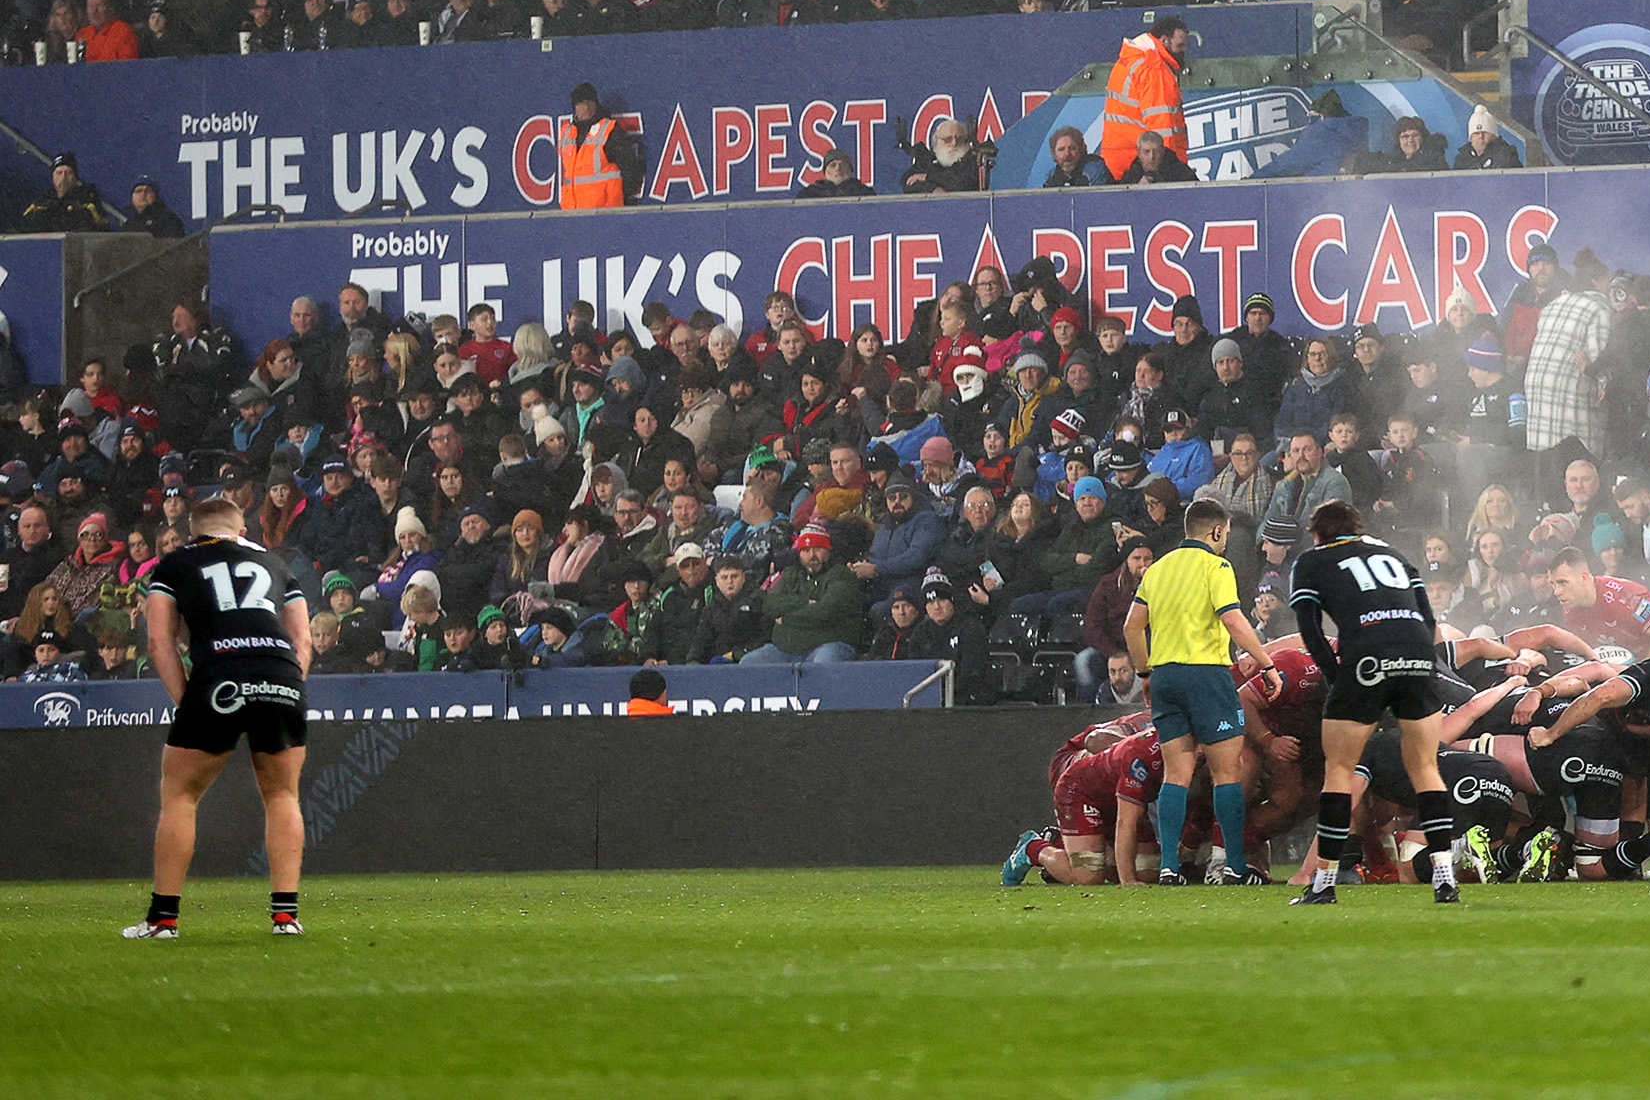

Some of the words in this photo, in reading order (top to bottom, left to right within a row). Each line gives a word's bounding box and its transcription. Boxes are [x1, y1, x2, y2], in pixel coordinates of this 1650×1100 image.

[1589, 64, 1635, 79] THE
[181, 110, 258, 136] Probably
[1187, 97, 1290, 148] THE
[1596, 122, 1630, 133] WALES
[178, 136, 308, 220] THE
[332, 125, 489, 213] UK'S
[351, 229, 449, 261] Probably
[349, 261, 508, 320] THE
[1290, 203, 1560, 331] CARS
[201, 561, 277, 615] 12
[1337, 554, 1411, 593] 10
[1360, 611, 1391, 624] DOOM
[1391, 609, 1411, 619] BAR
[213, 639, 250, 651] DOOM
[251, 637, 275, 648] BAR
[241, 681, 301, 701] Endurance
